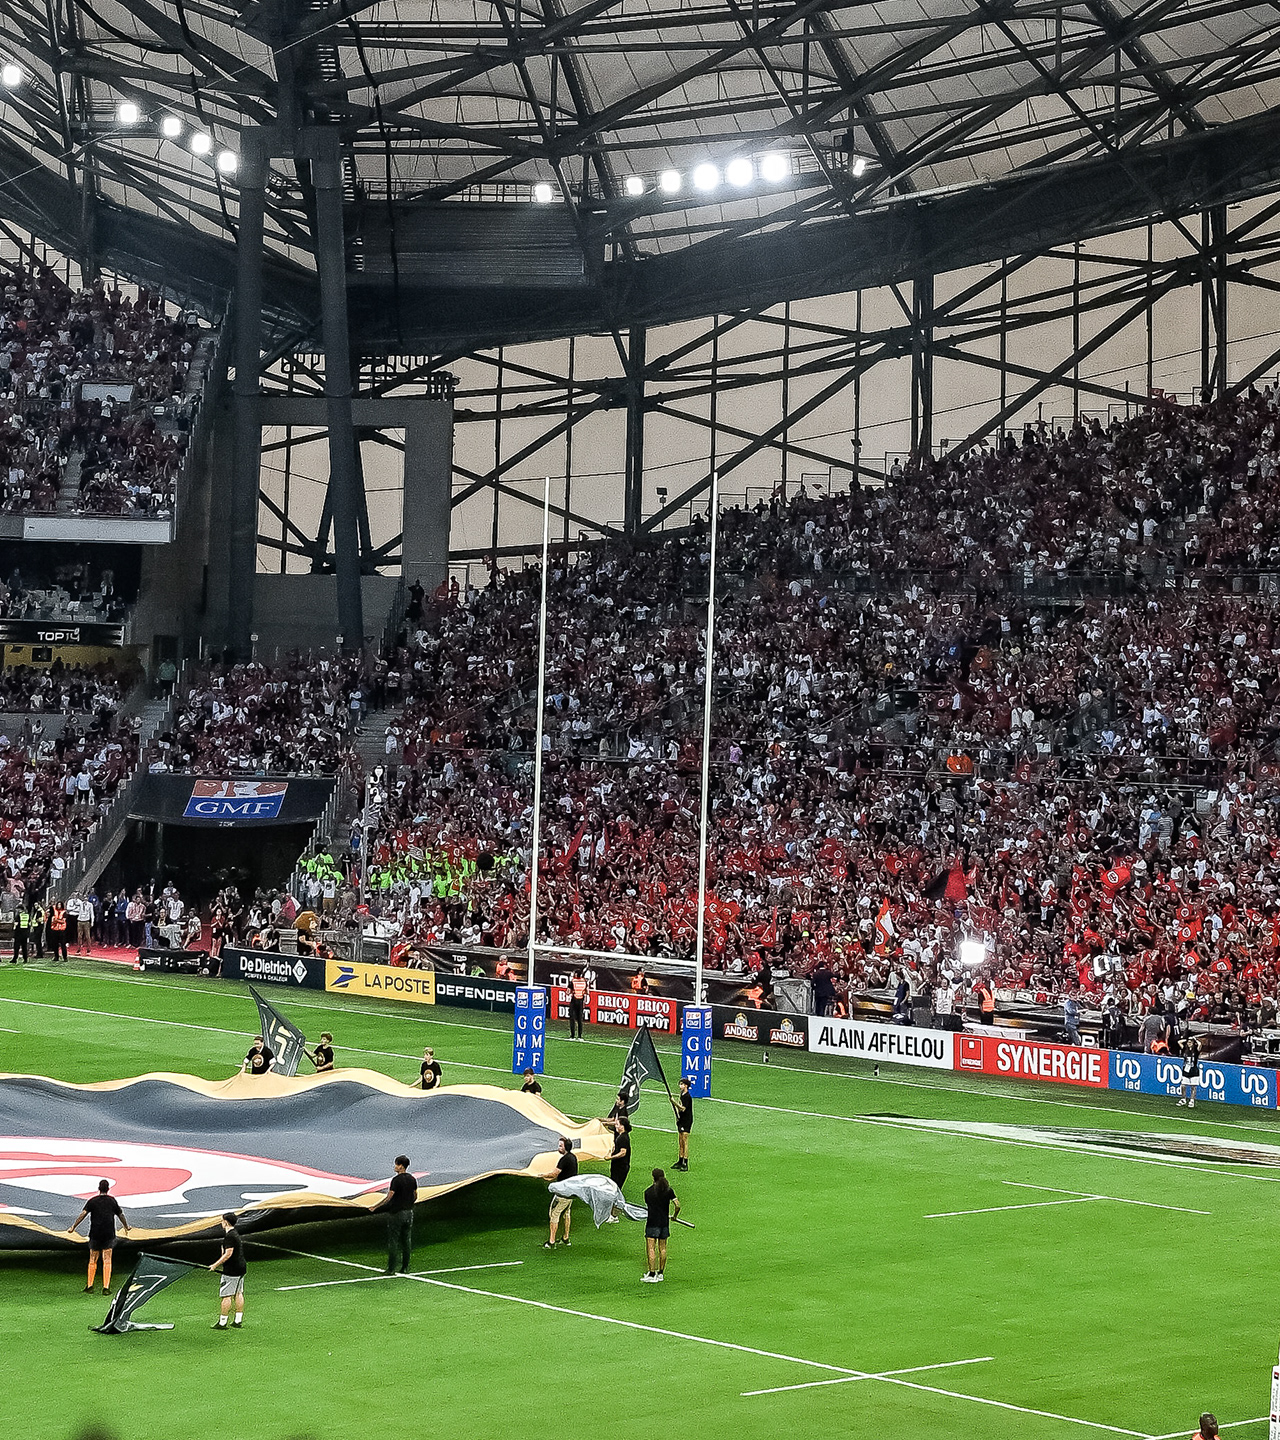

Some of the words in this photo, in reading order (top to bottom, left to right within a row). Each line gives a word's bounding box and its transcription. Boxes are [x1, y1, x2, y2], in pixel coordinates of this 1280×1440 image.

[194, 802, 274, 815] GMF
[239, 956, 254, 972] De
[255, 957, 292, 976] Dietrich
[364, 973, 382, 989] LA
[384, 975, 430, 995] POSTE
[436, 983, 516, 1003] DEFENDER
[597, 995, 630, 1009] BRICO
[637, 999, 670, 1013] BRICO
[597, 1009, 629, 1025] DEPÔT
[724, 1025, 758, 1039] ANDROS
[771, 1030, 805, 1044] ANDROS
[818, 1026, 865, 1051] ALAIN
[867, 1031, 945, 1060] AFFLELOU
[997, 1042, 1101, 1083] SYNERGIE
